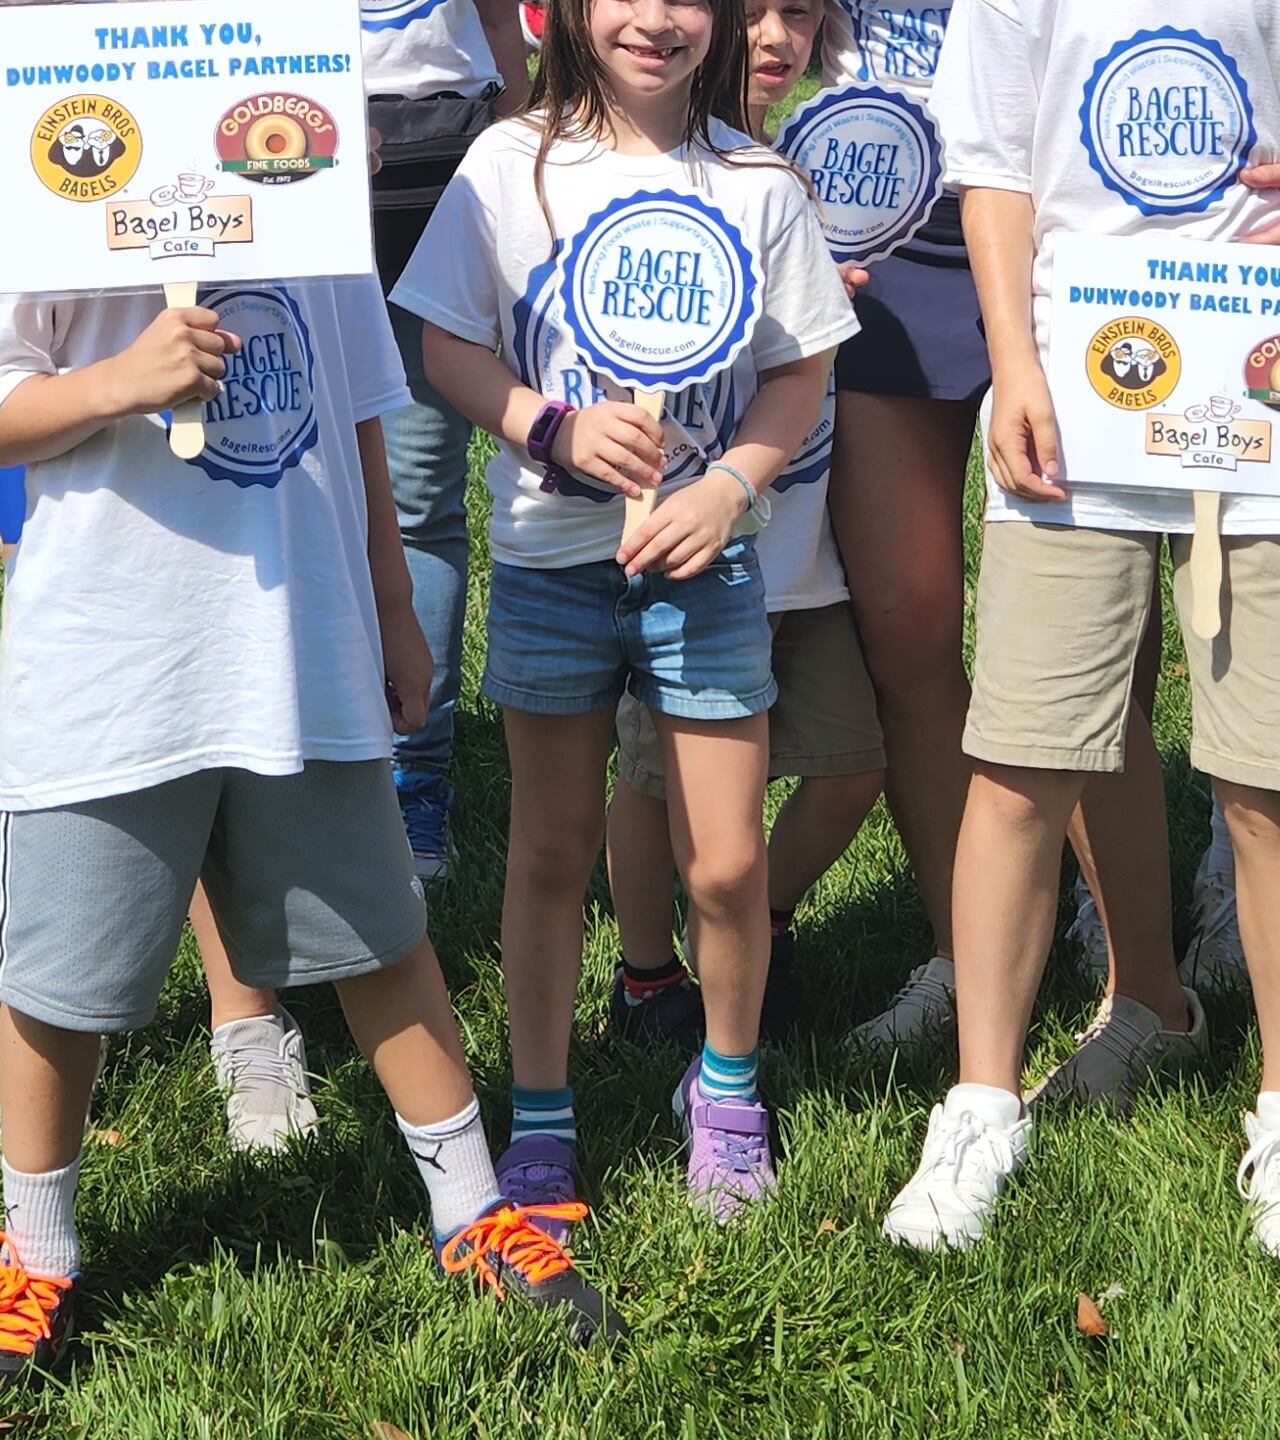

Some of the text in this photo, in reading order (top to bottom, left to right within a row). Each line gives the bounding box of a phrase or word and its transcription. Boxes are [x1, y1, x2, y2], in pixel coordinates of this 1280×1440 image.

[95, 22, 262, 50] THANK YOU,
[6, 54, 351, 86] DUNWOODY BAGEL PARTNERS!
[221, 95, 333, 136] GOLDBERGS
[1127, 86, 1213, 121] BAGEL
[37, 99, 135, 142] EINSTEIN BROS
[1116, 121, 1225, 157] RESCUE
[247, 158, 310, 171] FINE FOODS
[821, 137, 899, 176] BAGEL
[59, 175, 117, 197] BAGELS
[810, 168, 905, 209] RESCUE
[1129, 169, 1214, 189] BagelRescue.com
[112, 206, 245, 241] Bagel Boys
[622, 219, 651, 234] Waste
[659, 217, 708, 247] Supporting
[163, 239, 199, 253] Cafe
[616, 245, 703, 288] BAGEL
[1147, 260, 1229, 284] THANK
[601, 280, 715, 325] RESCUE
[1069, 286, 1182, 310] DUNWOODY
[1190, 294, 1252, 315] BAGEL
[609, 330, 696, 355] BagelRescue.com
[1092, 320, 1176, 359] EINSTEIN BROS
[1107, 388, 1158, 407] BAGELS
[1150, 418, 1264, 454] Bagel Boys
[1193, 453, 1223, 466] Cafe
